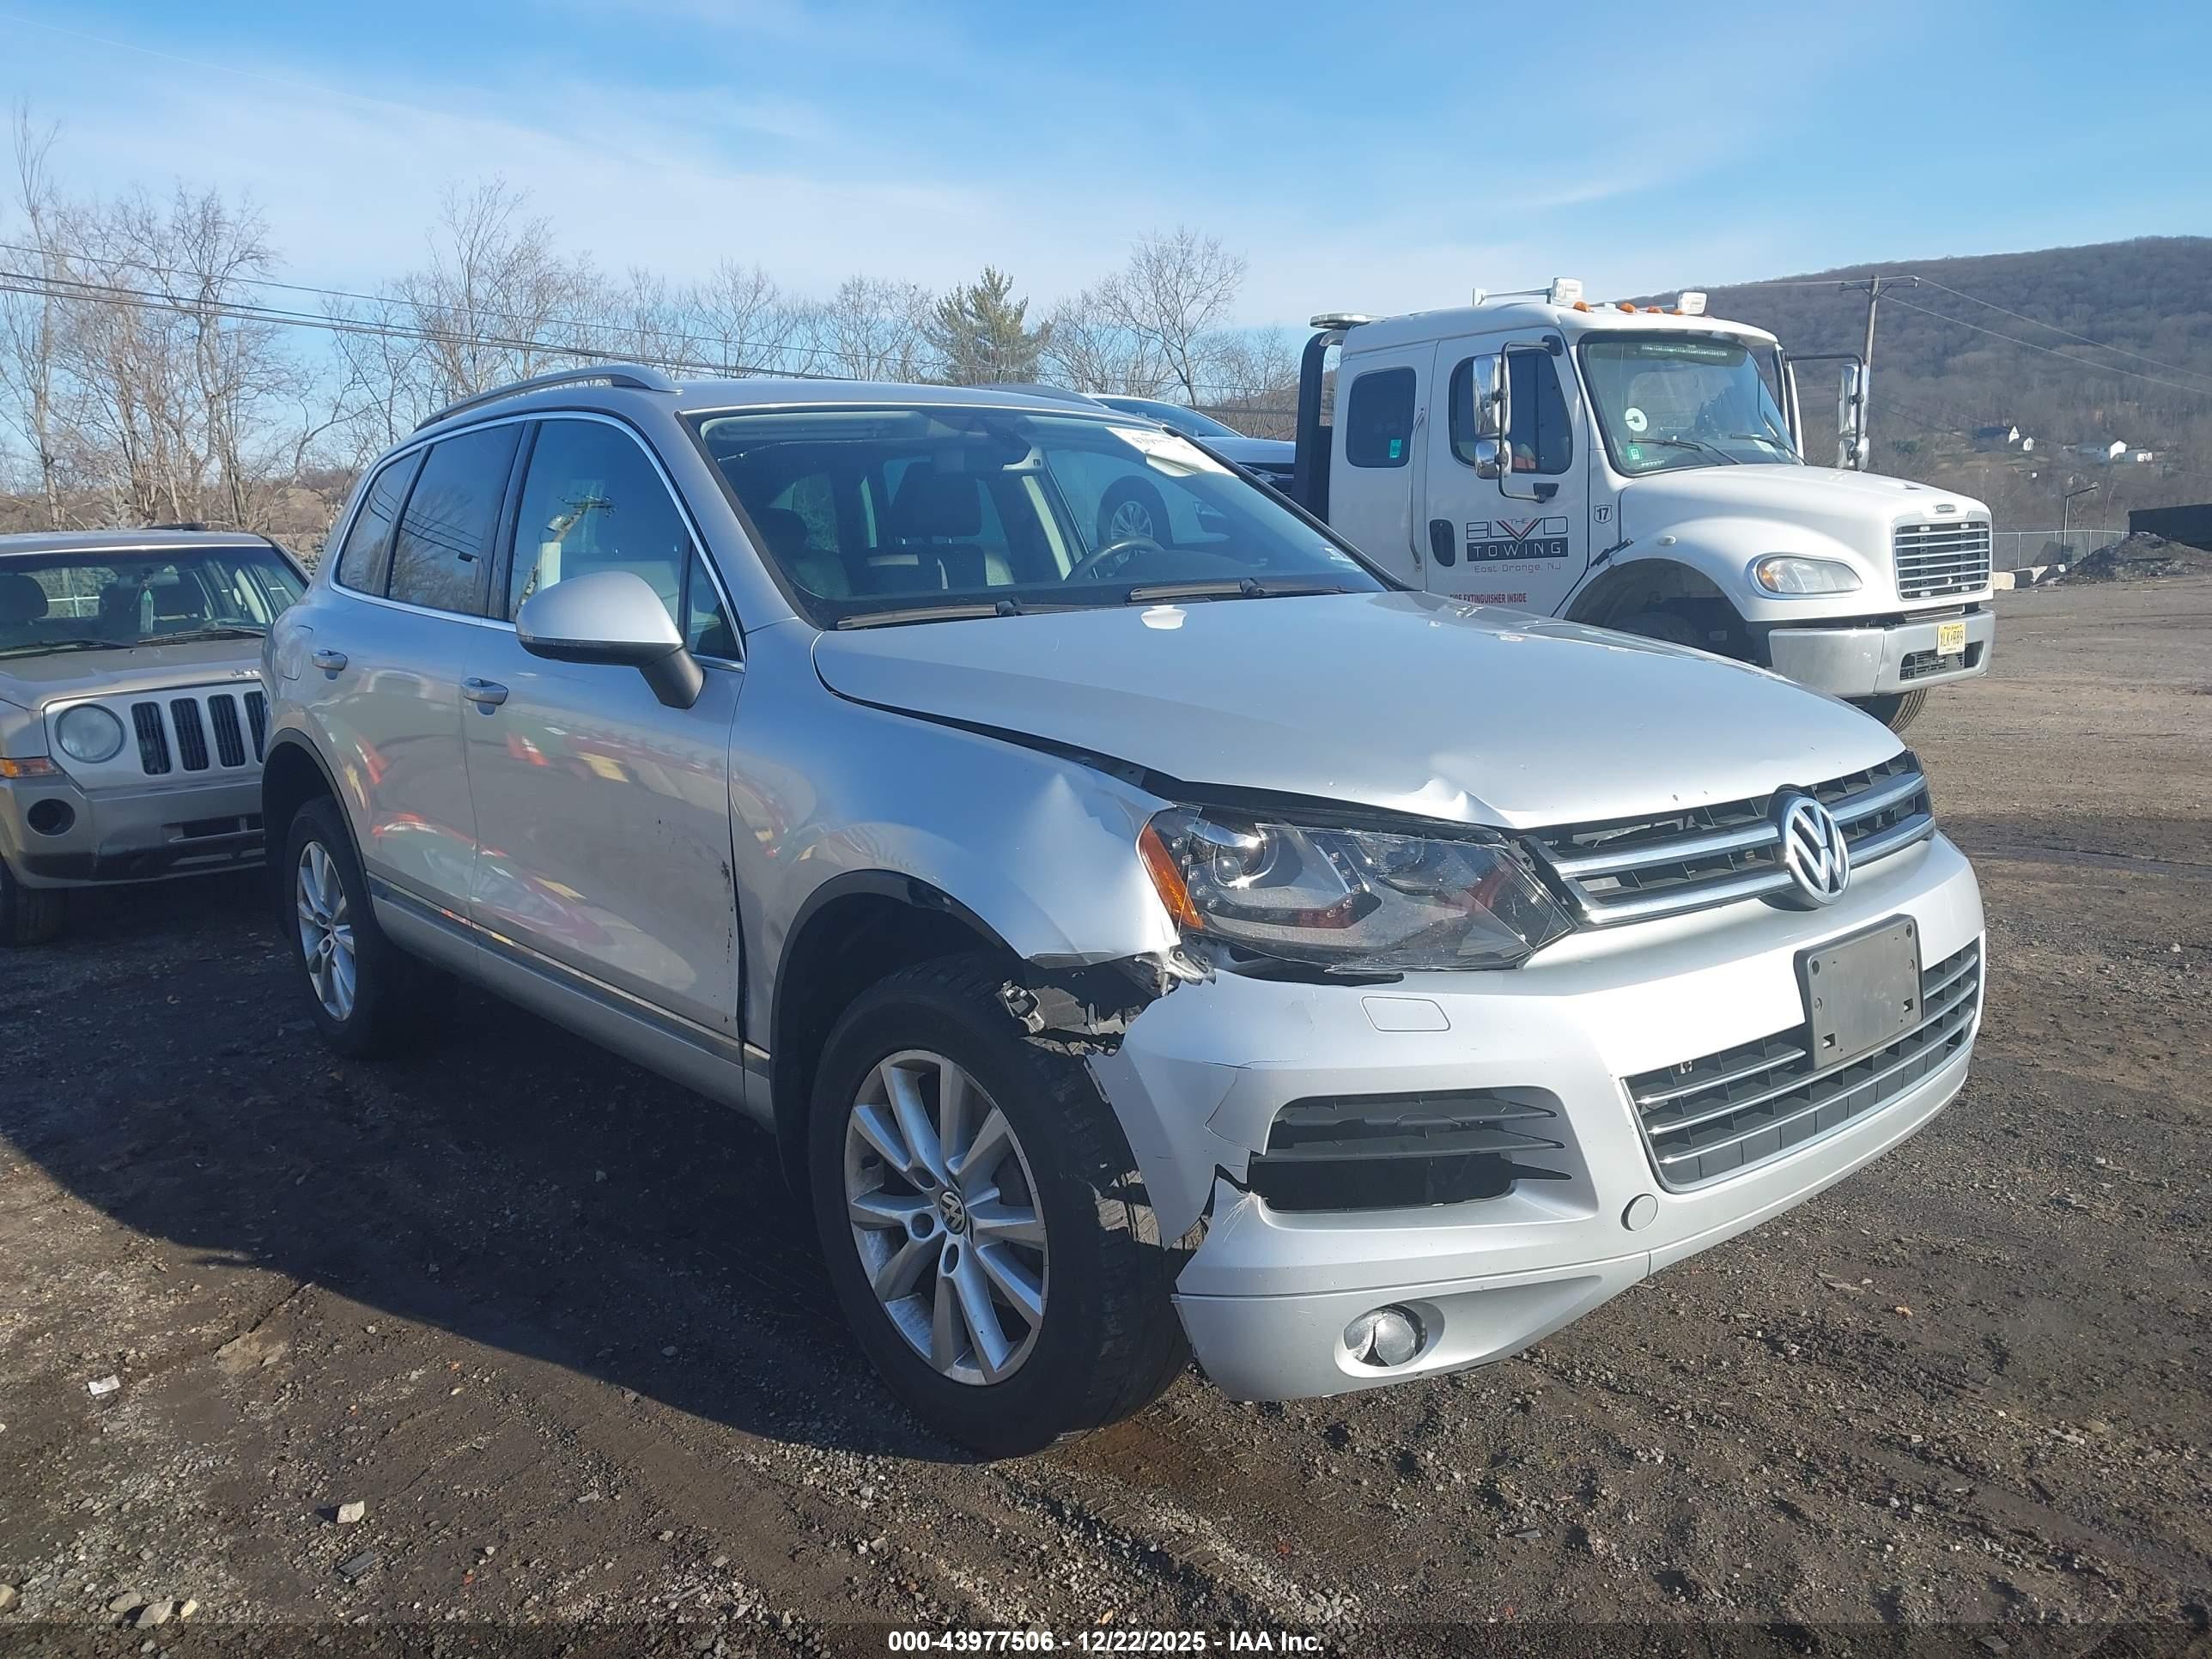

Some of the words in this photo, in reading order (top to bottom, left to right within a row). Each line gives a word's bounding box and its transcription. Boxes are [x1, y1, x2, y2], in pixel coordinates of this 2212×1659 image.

[1597, 507, 1609, 520] 17
[1467, 516, 1568, 542] BLVD
[1473, 542, 1561, 557] TOWING
[1474, 564, 1498, 574] East
[1547, 562, 1561, 571] NJ
[1463, 593, 1506, 604] EXTINGUISHER
[1507, 592, 1527, 603] INSIDE
